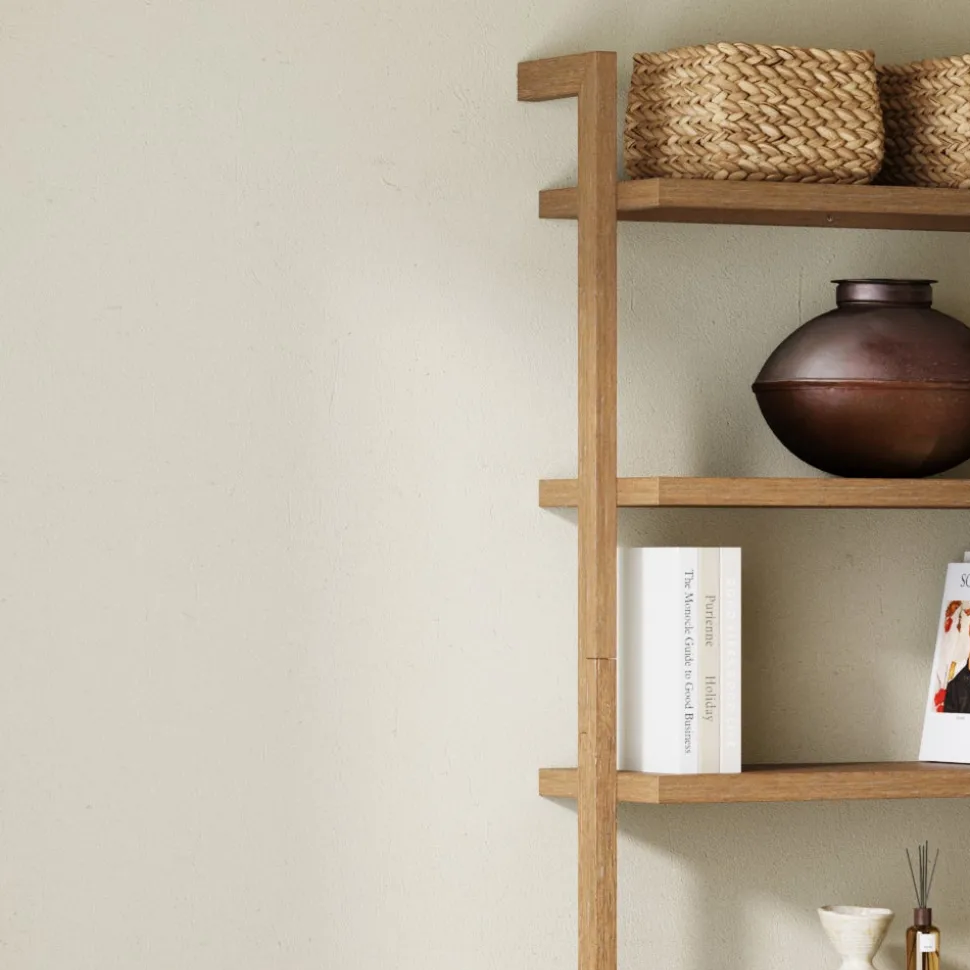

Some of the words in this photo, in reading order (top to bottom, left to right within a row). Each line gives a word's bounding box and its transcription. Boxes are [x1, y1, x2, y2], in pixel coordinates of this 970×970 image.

[684, 569, 694, 589] The
[684, 592, 694, 634] Monocle
[704, 595, 716, 647] Purienne
[684, 636, 694, 666] Guide
[684, 670, 692, 680] to
[684, 681, 694, 709] Good
[702, 676, 716, 722] Holiday
[684, 713, 694, 754] Business
